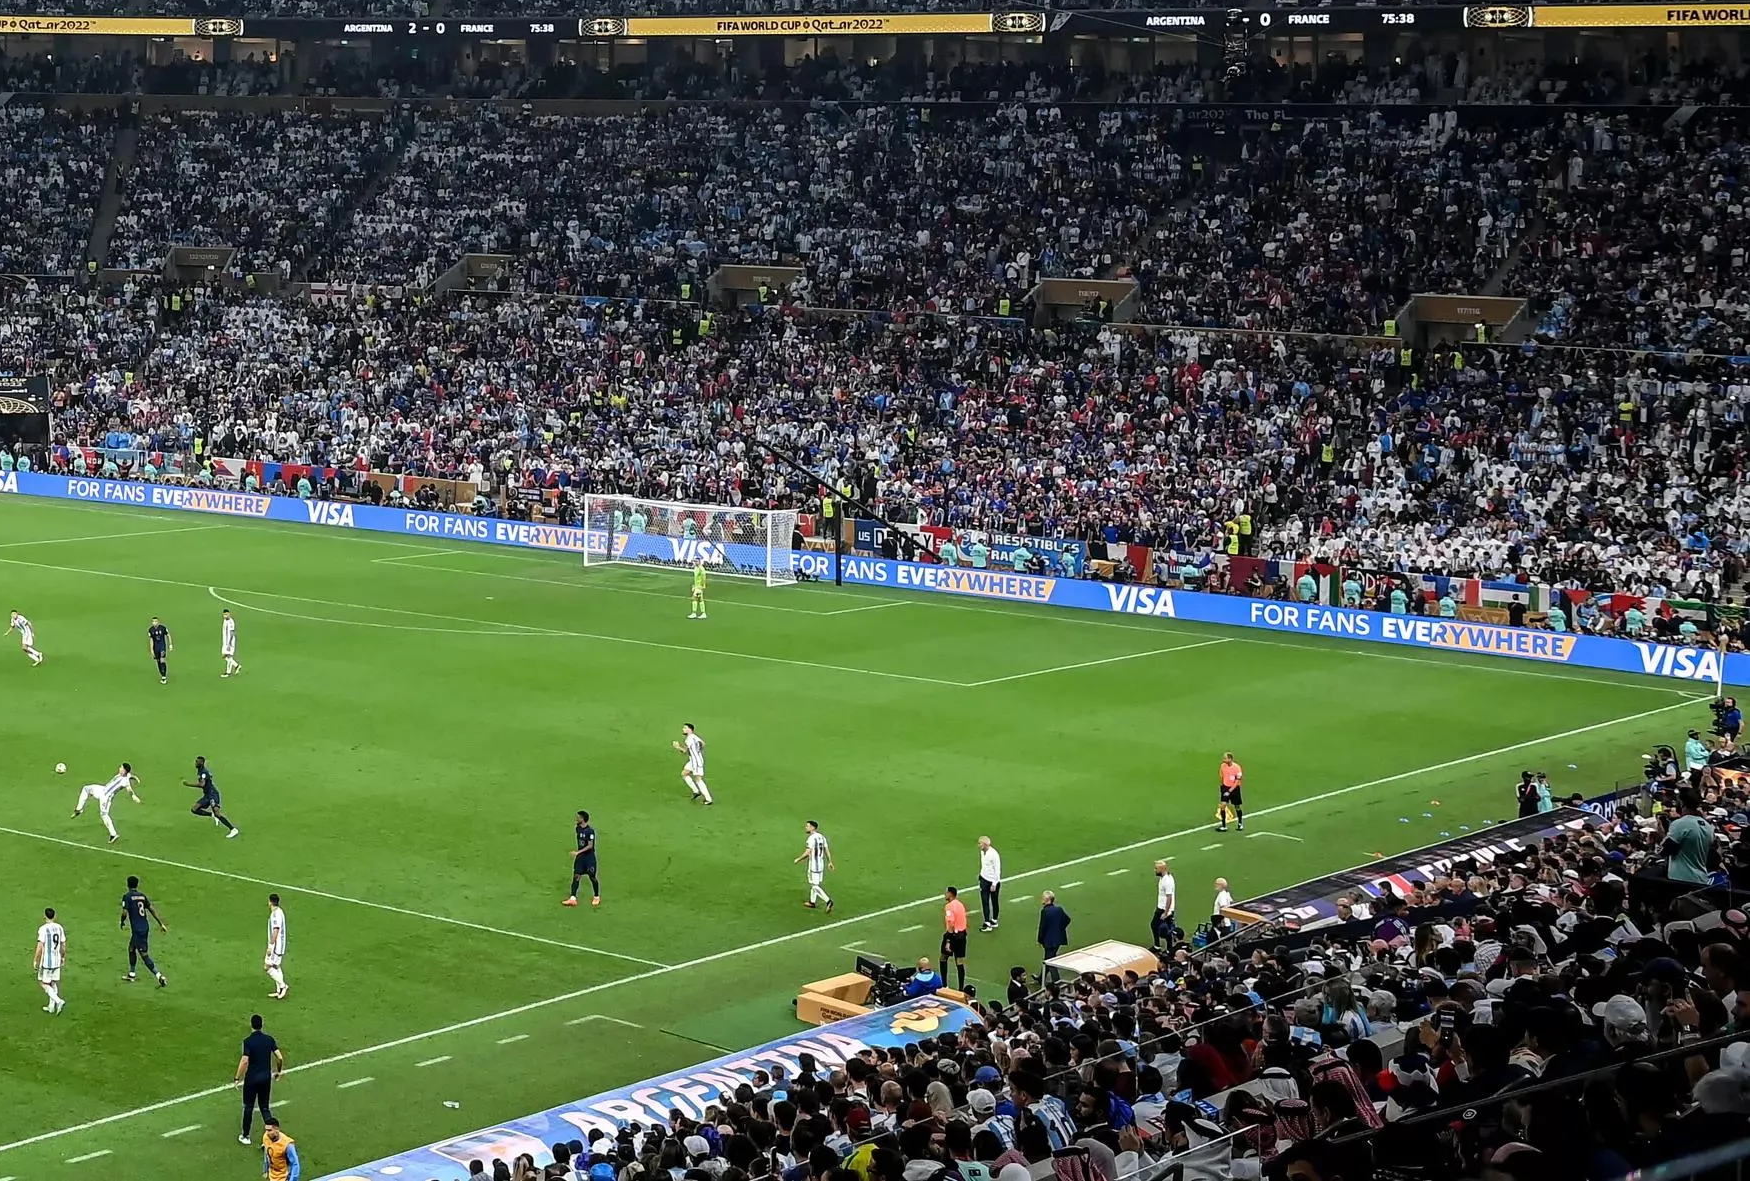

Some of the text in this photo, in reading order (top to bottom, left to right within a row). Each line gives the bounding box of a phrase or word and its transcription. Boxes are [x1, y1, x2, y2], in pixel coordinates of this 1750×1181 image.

[343, 23, 394, 33] ARGENTINA
[408, 23, 417, 33] 2
[435, 22, 446, 34] 0
[460, 23, 494, 33] FRANCE
[529, 23, 555, 33] 75:38
[717, 21, 741, 31] FIFA
[742, 20, 781, 31] WORLD
[783, 20, 802, 30] CUP
[1146, 15, 1206, 27] ARGENTINA
[1259, 13, 1271, 27] 0
[1288, 14, 1330, 25] FRANCE
[1381, 13, 1415, 25] 75:38
[1667, 10, 1699, 22] FIFA
[67, 479, 265, 514] FOR FANS EVERYWHERE
[304, 499, 354, 528] VISA
[405, 513, 442, 535] FOR
[444, 517, 488, 539] FANS
[669, 537, 725, 564] VISA
[790, 553, 830, 577] FOR
[896, 564, 1047, 598] EVERYWHERE
[1102, 583, 1176, 618] VISA
[1251, 603, 1565, 657] FOR FANS EVERYWHERE
[1632, 641, 1720, 683] VISA
[137, 901, 146, 917] 8
[52, 933, 60, 951] 9
